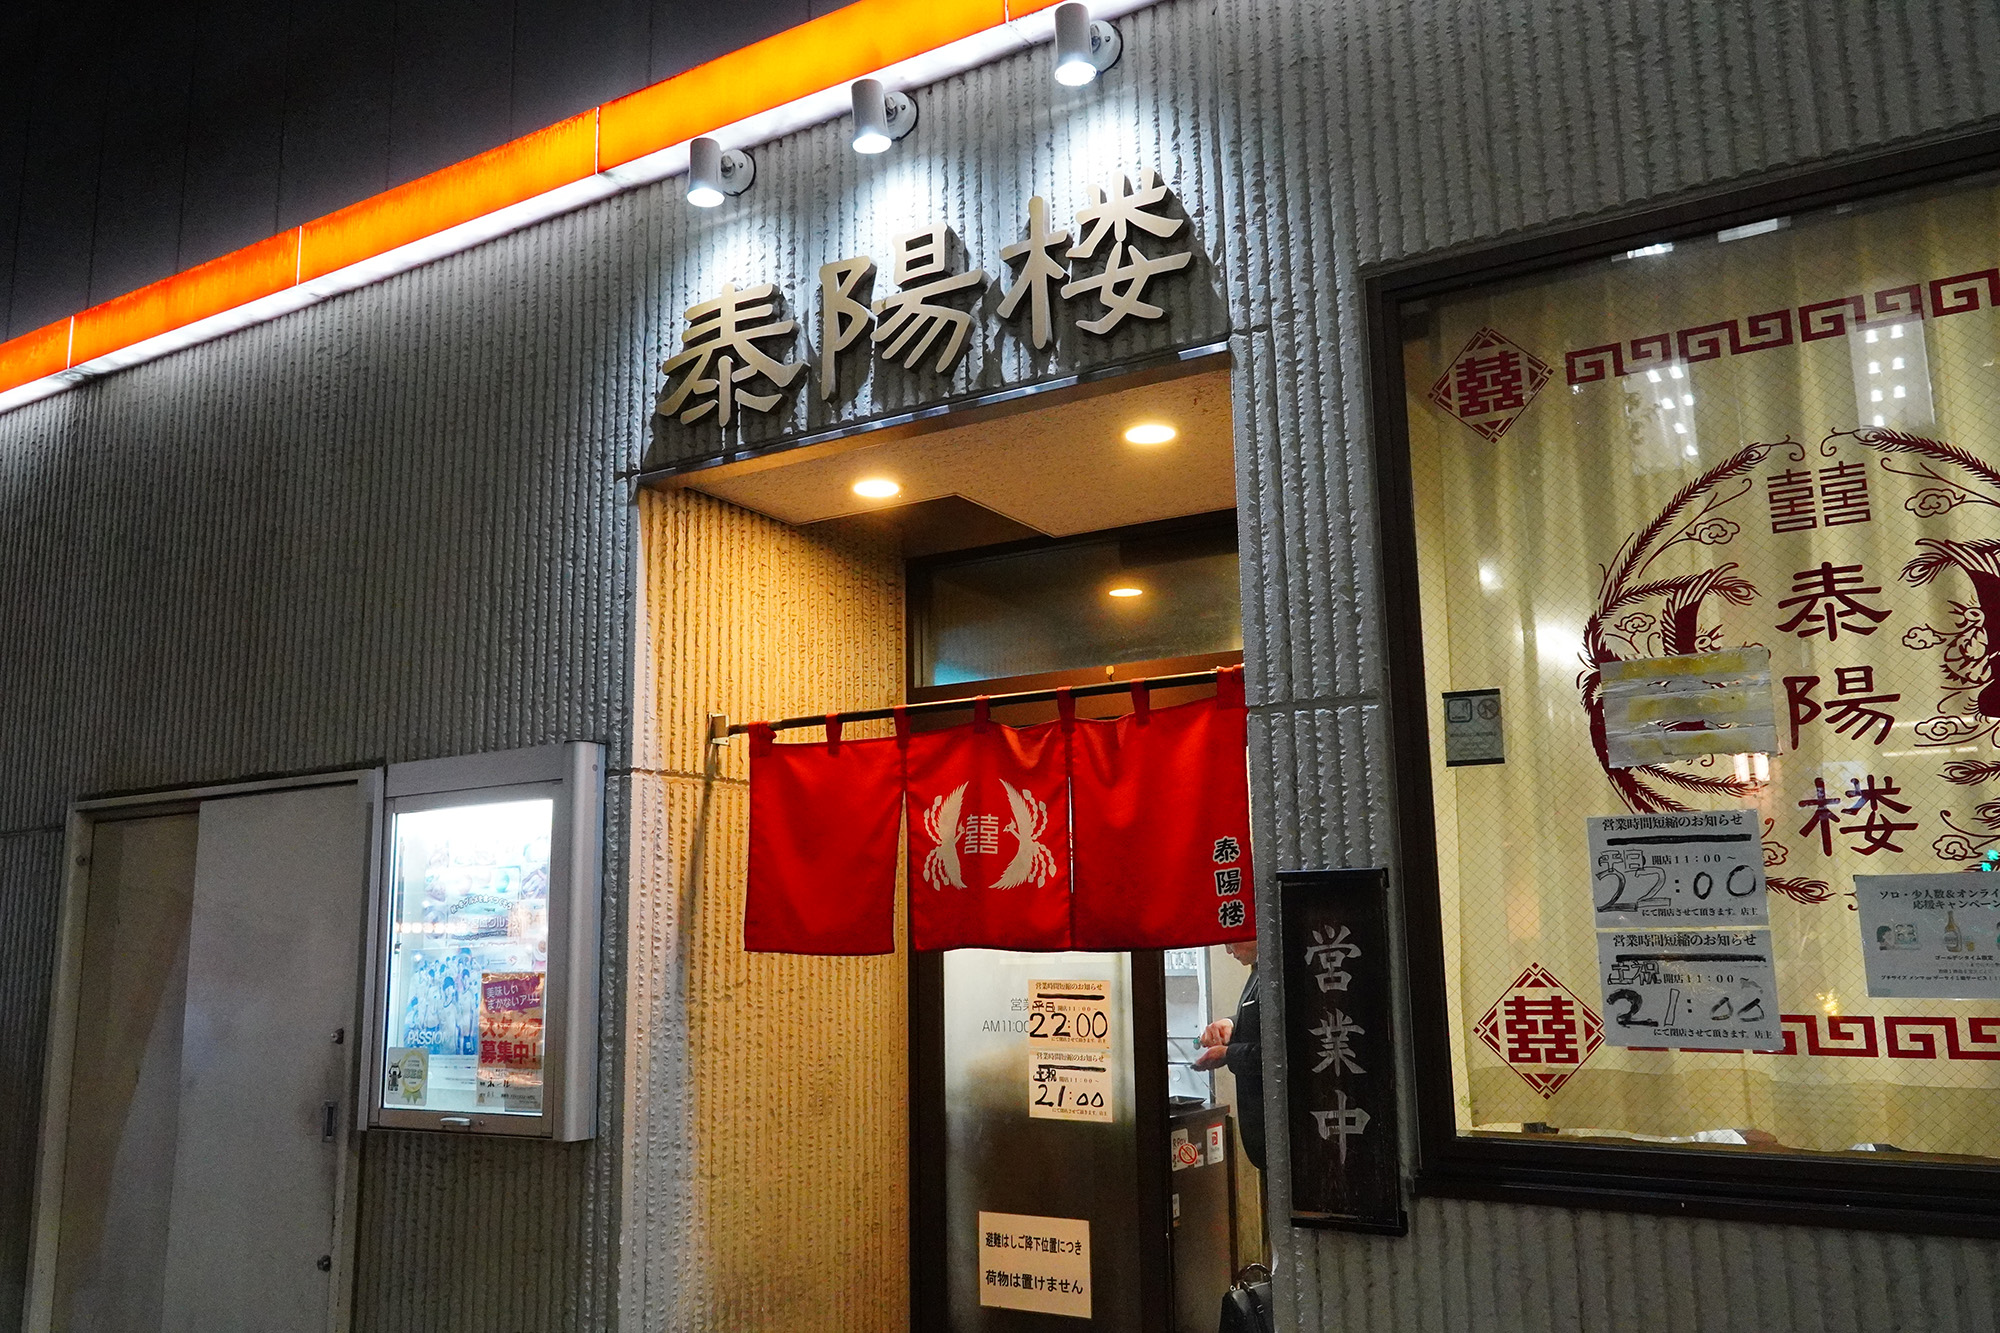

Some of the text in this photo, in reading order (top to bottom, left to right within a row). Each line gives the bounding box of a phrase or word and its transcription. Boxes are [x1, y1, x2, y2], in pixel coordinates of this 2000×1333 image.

[659, 167, 1193, 429] 泰陽楼
[1775, 562, 1918, 857] 泰陽楼
[1602, 814, 1743, 831] 営業時間短縮のお知らせ
[1213, 835, 1245, 929] 泰陽楼
[1595, 864, 1757, 913] 22:00
[1741, 907, 1758, 917] 店主
[1613, 933, 1757, 947] 営業時間短縮のお知らせ
[1607, 960, 1662, 986] 土祝
[486, 984, 519, 999] 美味しい
[1035, 982, 1103, 991] 営業時間短縮のお知らせ
[1032, 1000, 1056, 1012] 平日
[1606, 988, 1765, 1029] 21:00
[1029, 1011, 1108, 1038] 22:00
[1754, 1030, 1773, 1040] 店主
[480, 1040, 537, 1064] 募集中！
[1303, 923, 1372, 1166] 営業中
[1036, 1052, 1104, 1062] 営業時間短縮のお知らせ
[1035, 1084, 1104, 1107] 21:00
[985, 1232, 1082, 1255] 避難はしご降下位置につき
[985, 1269, 1084, 1294] 荷物は置けません
